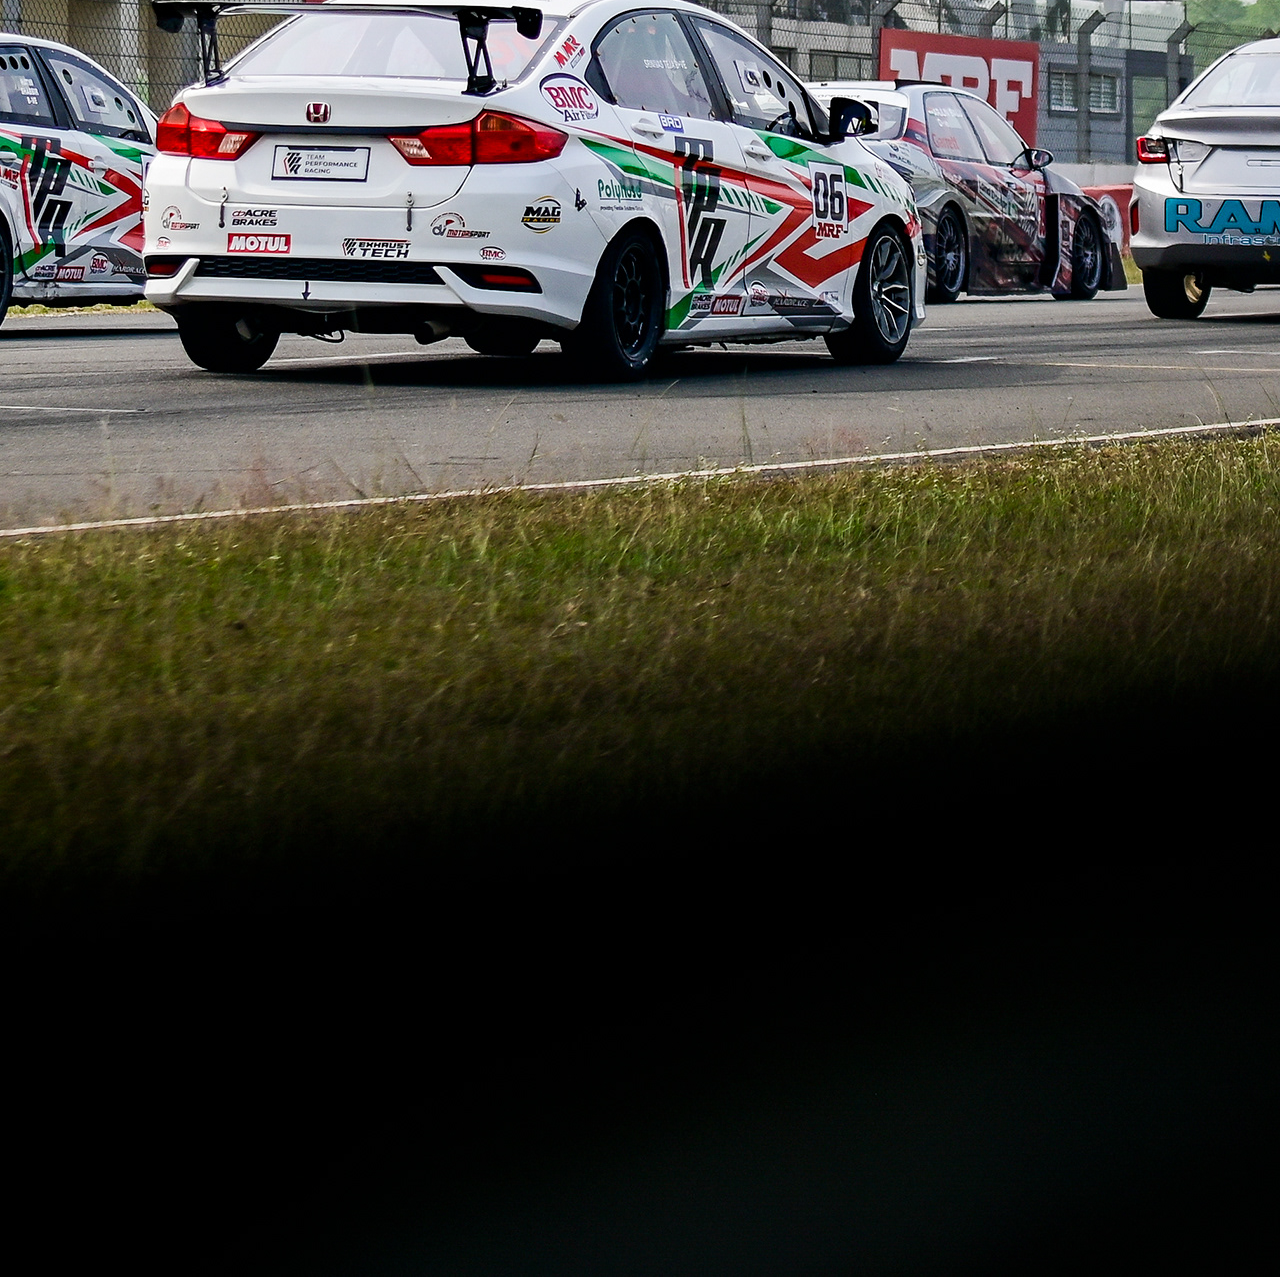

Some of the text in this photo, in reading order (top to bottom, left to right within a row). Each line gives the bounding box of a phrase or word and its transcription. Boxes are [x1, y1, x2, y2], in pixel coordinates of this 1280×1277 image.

[544, 87, 593, 110] BMC
[564, 109, 580, 122] Air
[597, 178, 643, 203] Polyhose
[814, 171, 844, 222] 06
[245, 209, 278, 218] ACRE
[523, 206, 562, 217] MAG
[817, 222, 844, 239] MRF
[228, 236, 289, 251] MOTUL
[358, 241, 412, 249] EXHAUST
[359, 249, 410, 258] TECH
[481, 249, 504, 258] BMC
[57, 268, 83, 279] MOTUL
[714, 299, 740, 312] MOTUL
